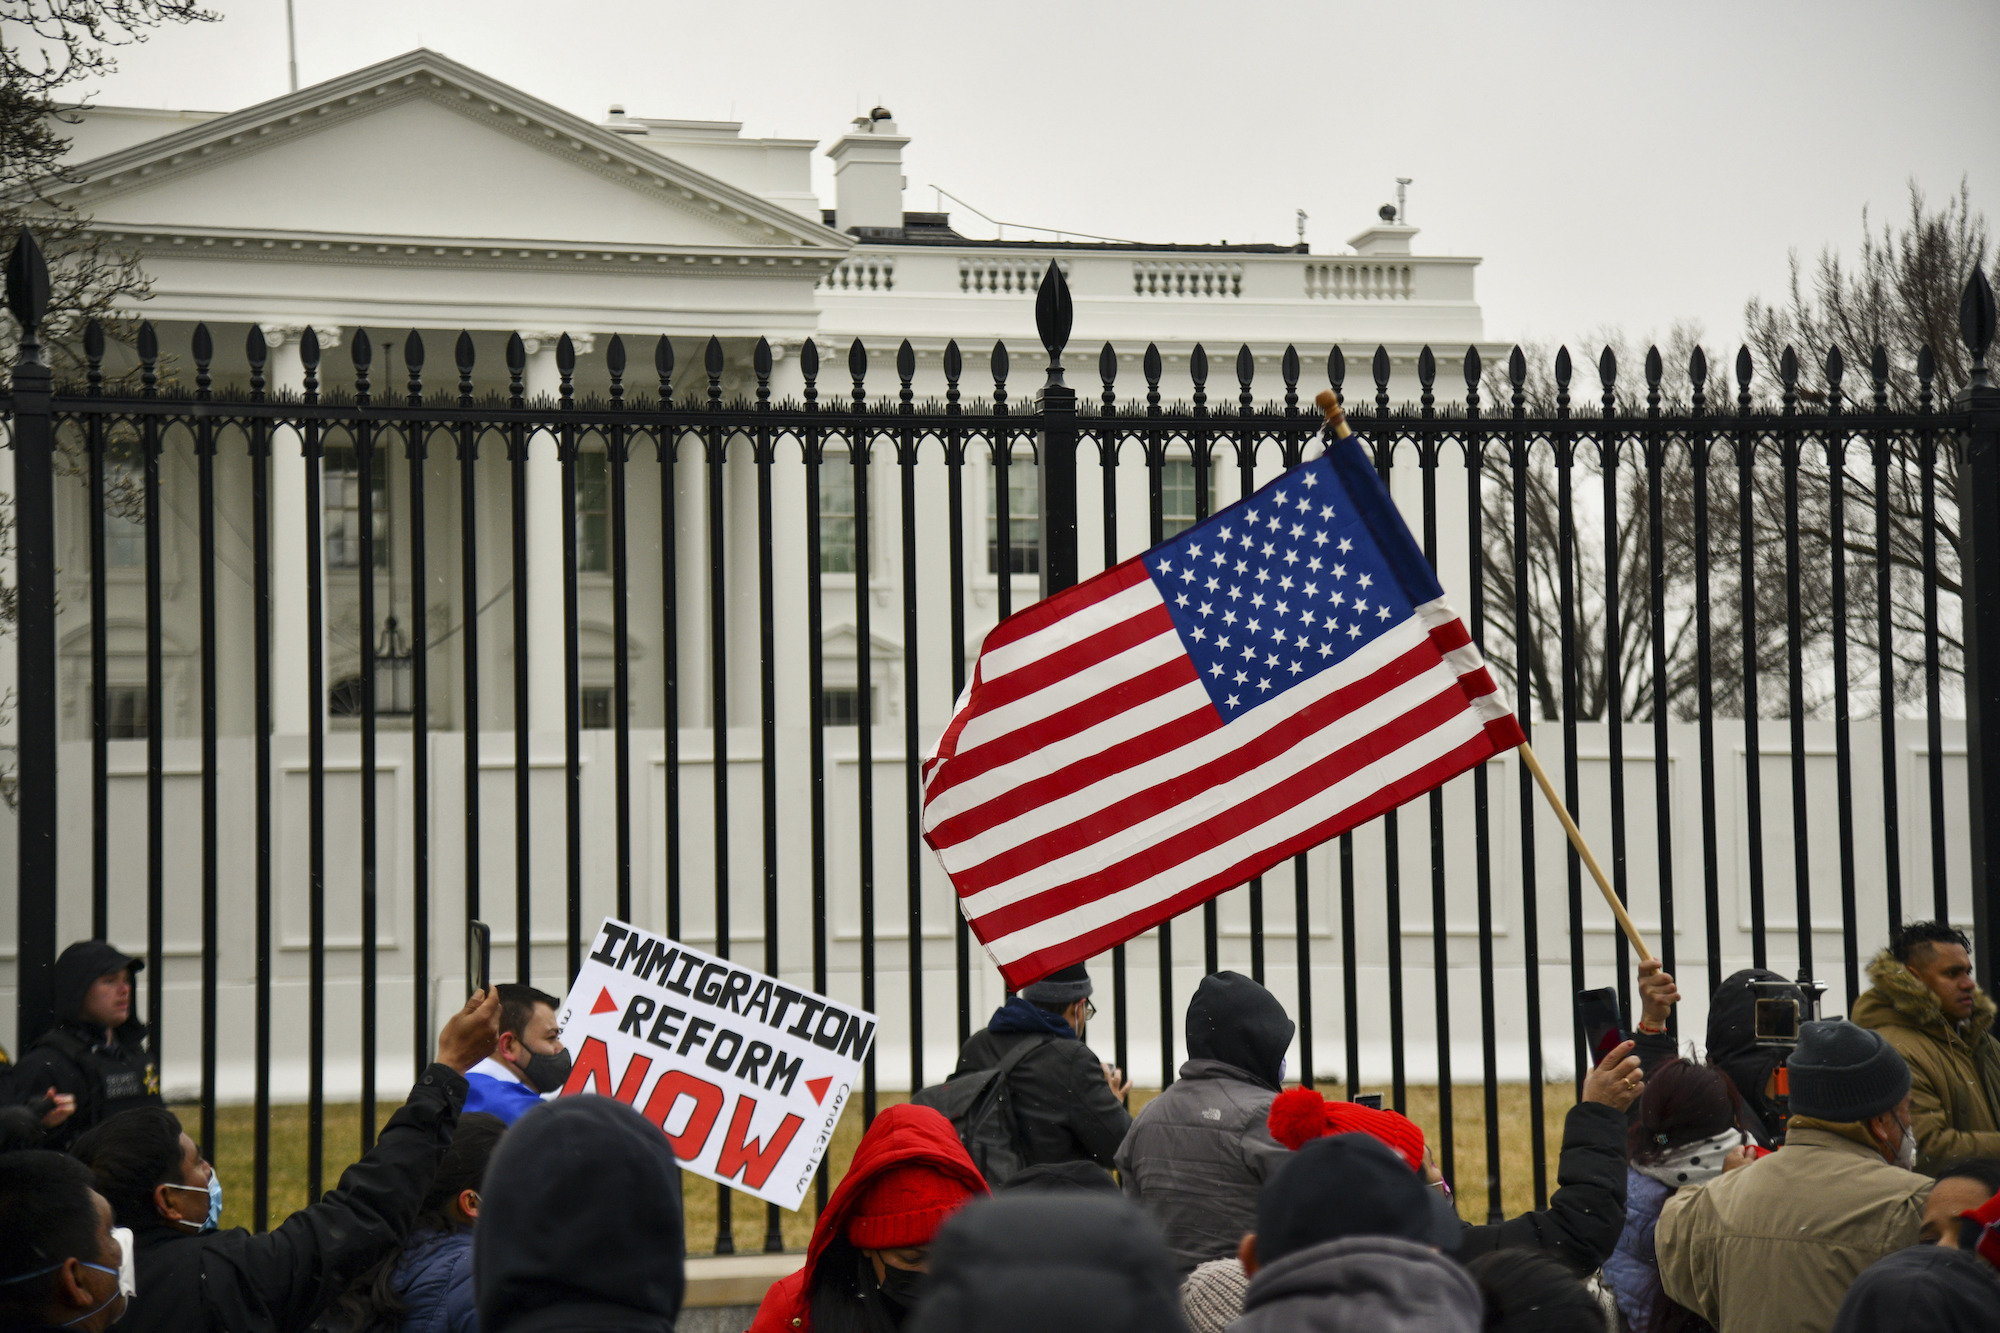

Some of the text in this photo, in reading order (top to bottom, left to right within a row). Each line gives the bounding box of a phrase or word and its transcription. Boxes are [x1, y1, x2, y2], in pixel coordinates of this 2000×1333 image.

[590, 922, 876, 1063] IMMIGRATION
[617, 995, 804, 1097] REFORM
[558, 1035, 805, 1190] NOW
